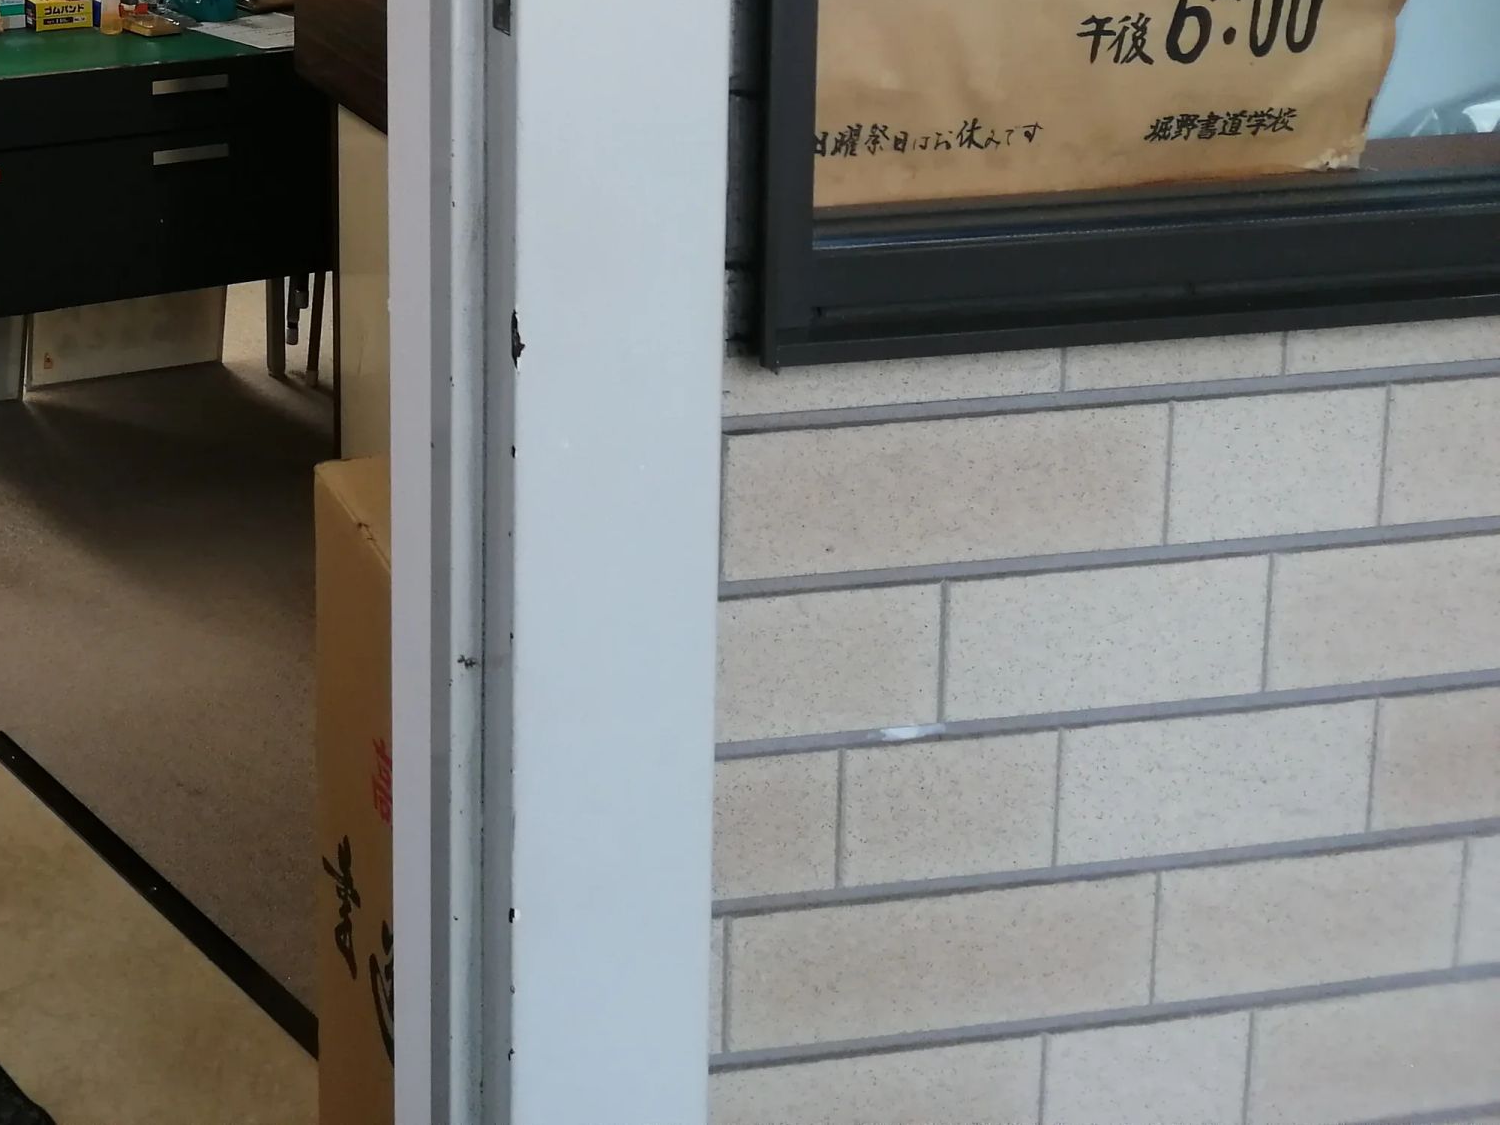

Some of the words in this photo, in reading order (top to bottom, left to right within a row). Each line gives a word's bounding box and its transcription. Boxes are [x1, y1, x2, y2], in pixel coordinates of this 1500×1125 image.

[1076, 13, 1155, 66] 午後
[1143, 106, 1297, 143] 堀野書道学校
